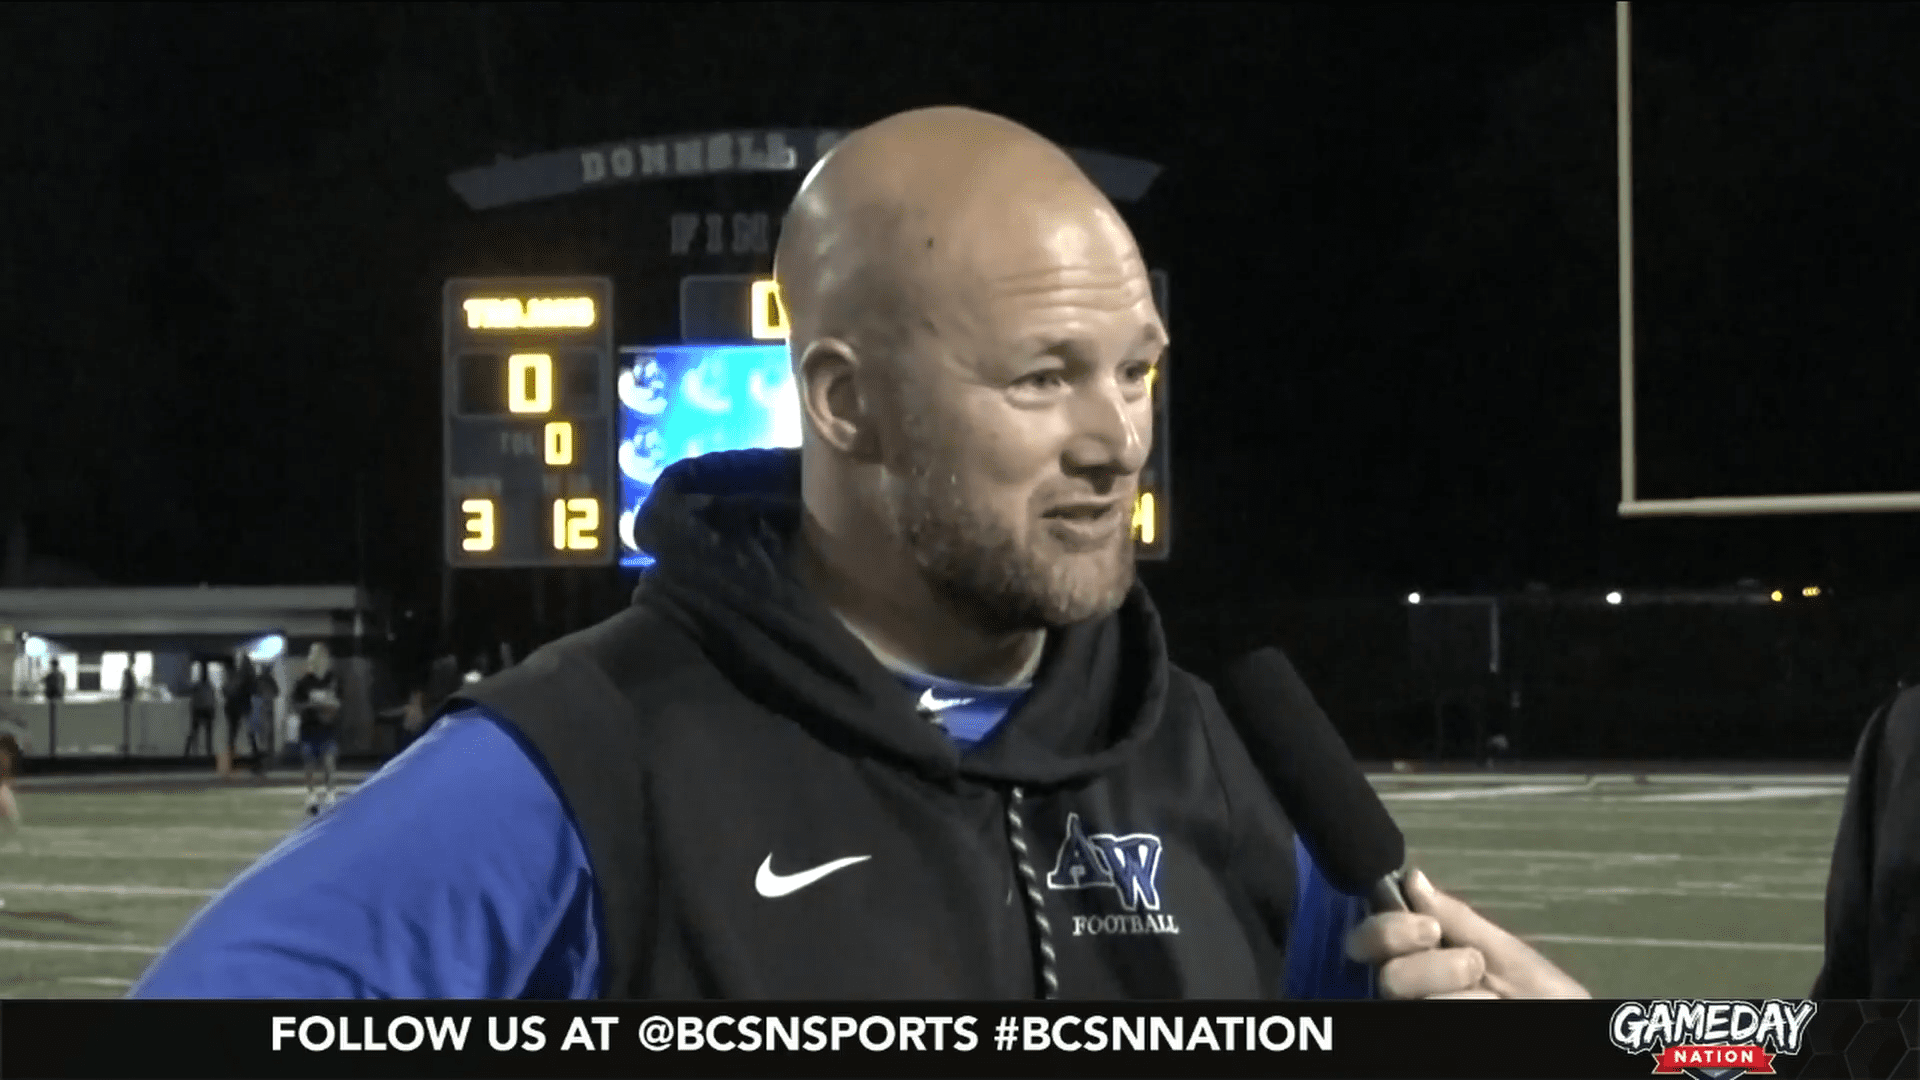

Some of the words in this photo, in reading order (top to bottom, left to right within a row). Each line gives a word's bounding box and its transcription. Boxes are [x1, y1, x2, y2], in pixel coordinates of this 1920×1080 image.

[508, 354, 553, 414] 0
[544, 422, 573, 466] 0
[462, 499, 495, 551] 3
[553, 498, 600, 551] 12
[1047, 812, 1163, 912] AW
[1072, 914, 1180, 937] FOOTBALL
